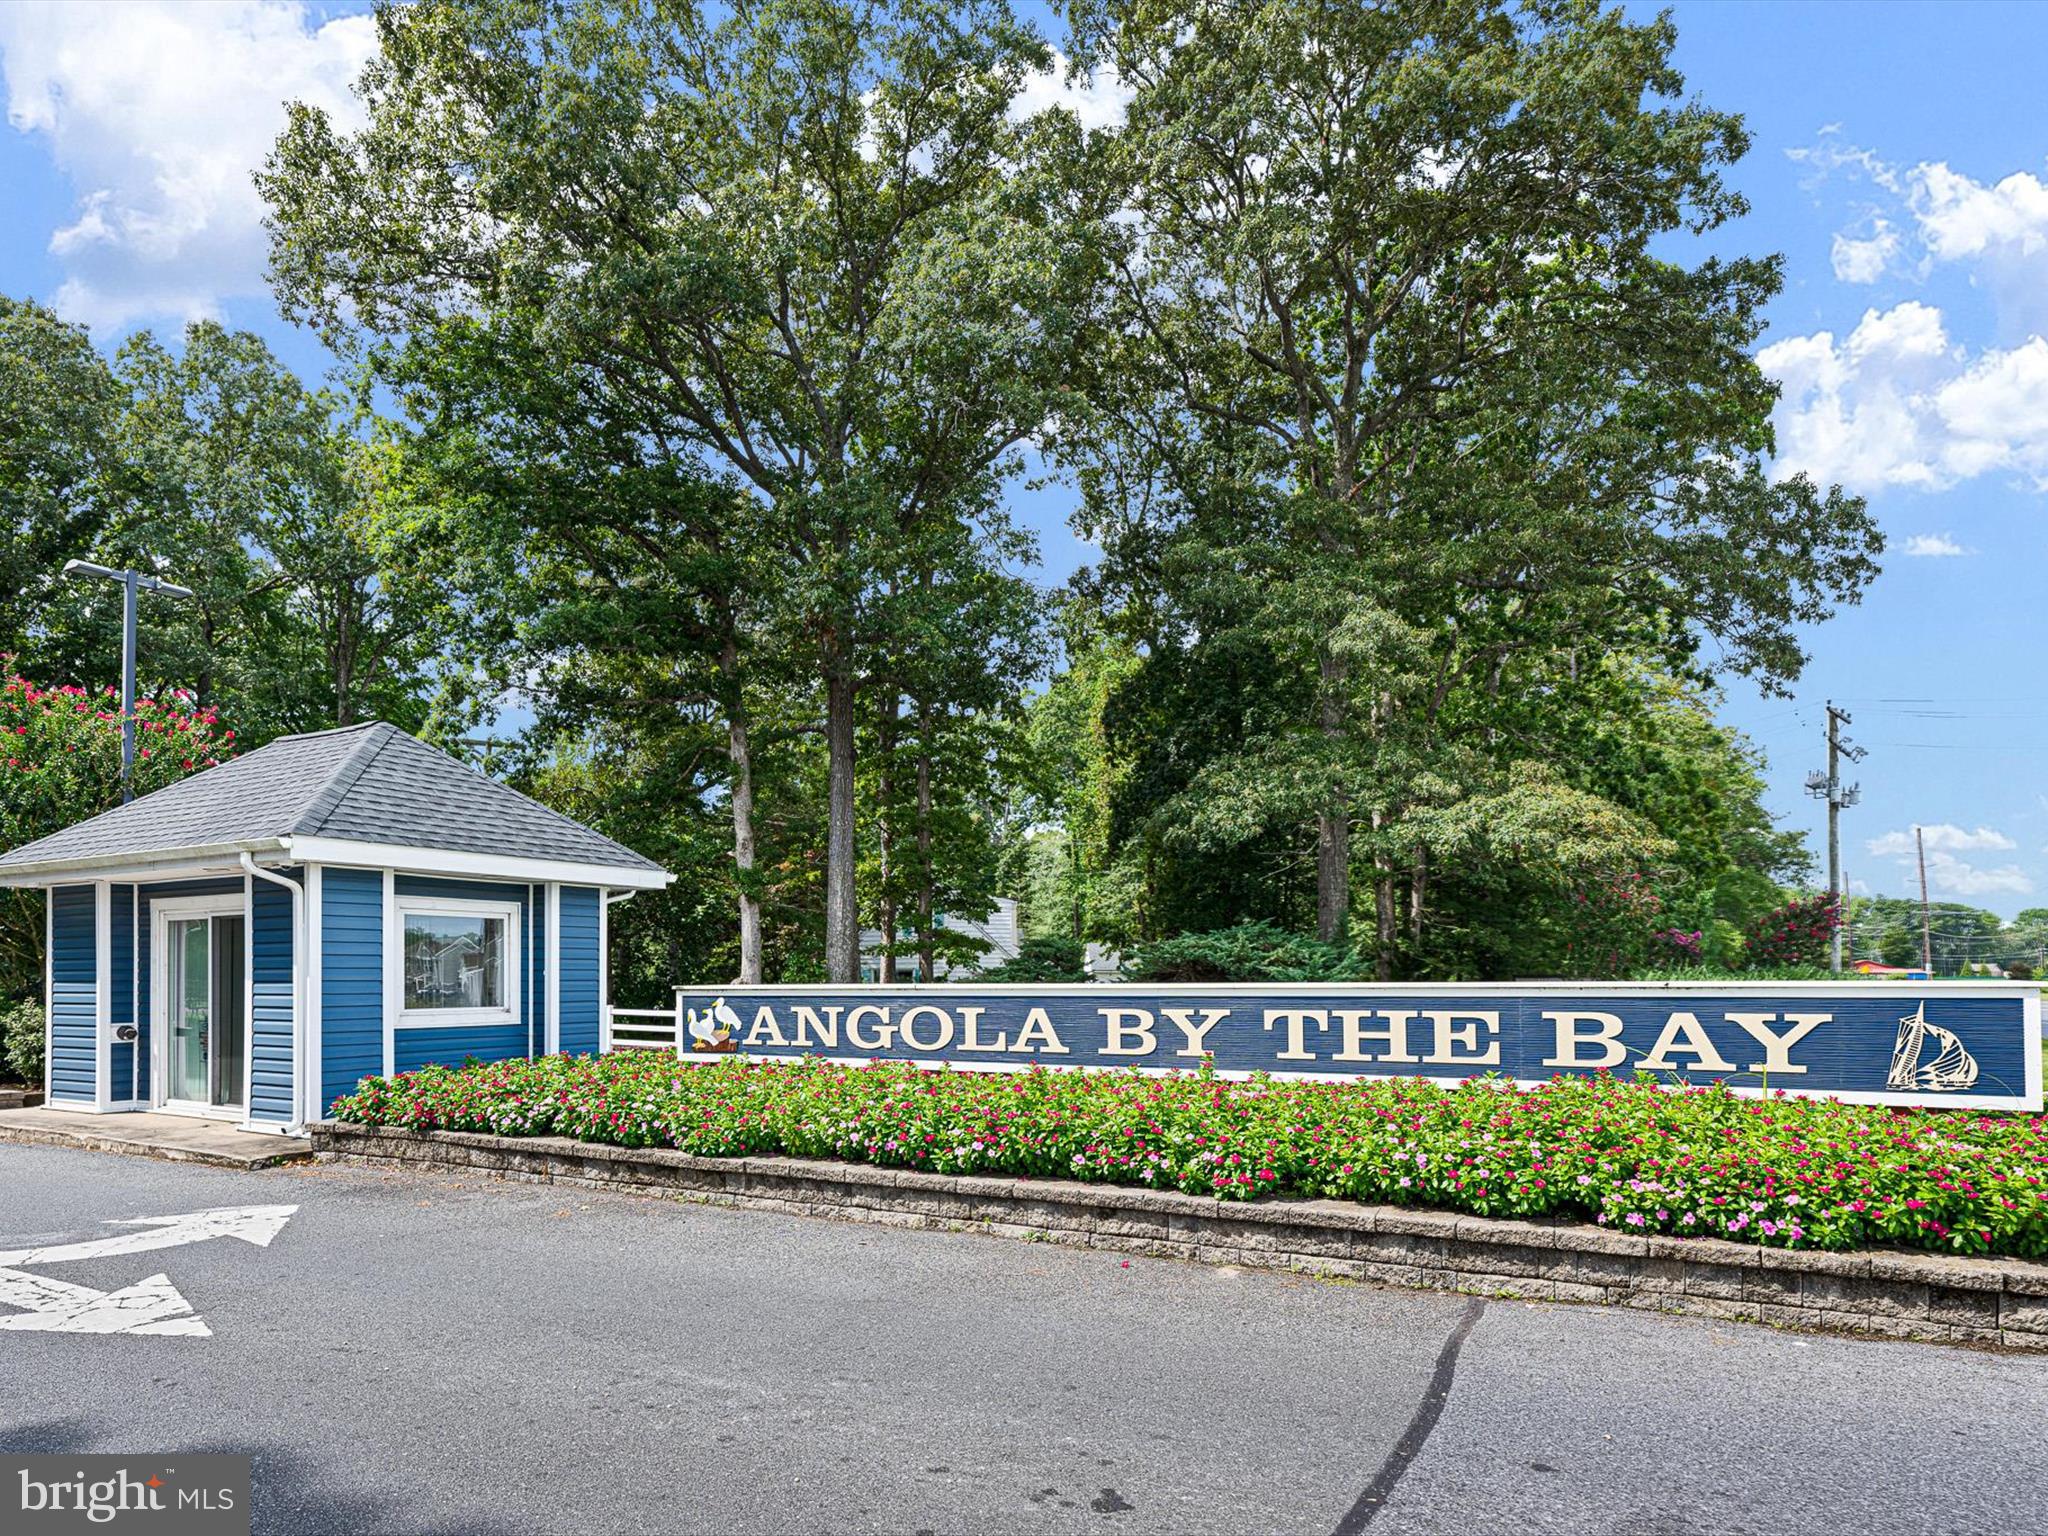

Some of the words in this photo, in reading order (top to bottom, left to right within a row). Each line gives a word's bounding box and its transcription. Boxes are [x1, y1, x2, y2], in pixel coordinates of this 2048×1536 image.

[743, 1005, 1070, 1054] ANGOLA
[1099, 1008, 1231, 1057] BY
[1263, 1009, 1500, 1065] THE
[1542, 1011, 1833, 1073] BAY
